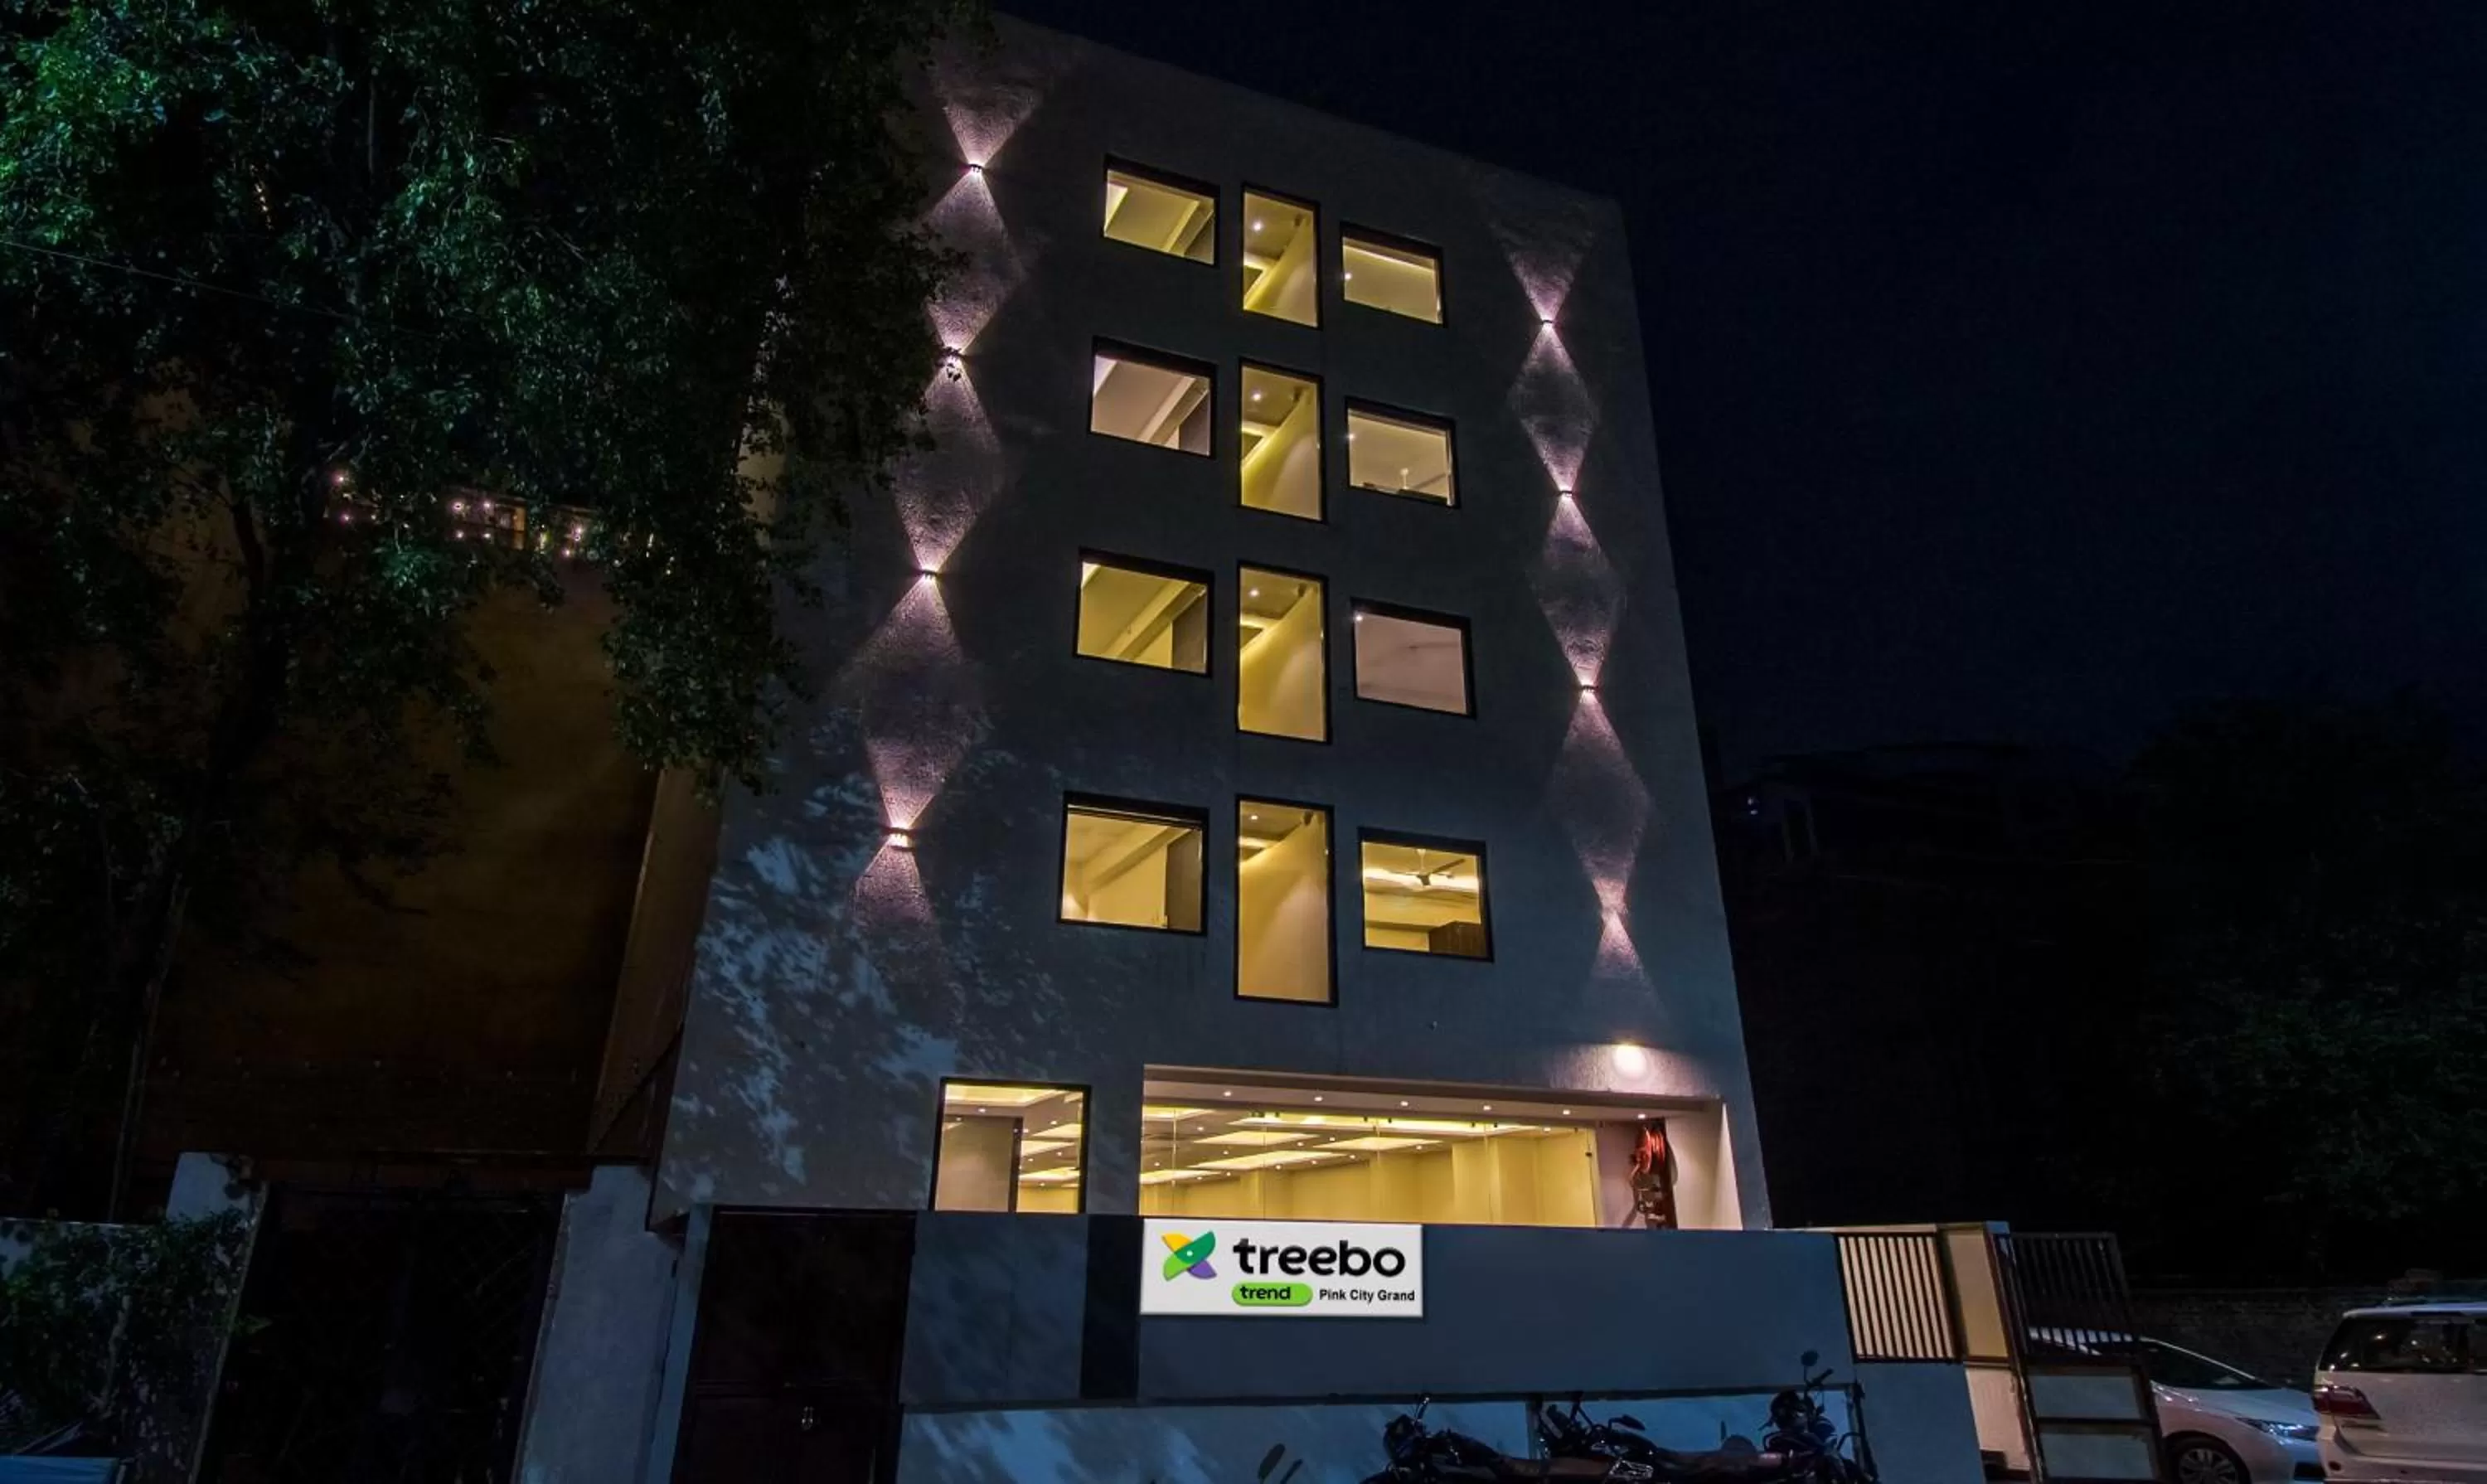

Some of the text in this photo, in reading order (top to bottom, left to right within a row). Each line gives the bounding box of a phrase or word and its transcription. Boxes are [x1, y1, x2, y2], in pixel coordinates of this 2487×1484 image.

[1232, 1238, 1407, 1278] treebo
[1239, 1286, 1292, 1301] trend
[1319, 1288, 1416, 1304] Pink City Grand
